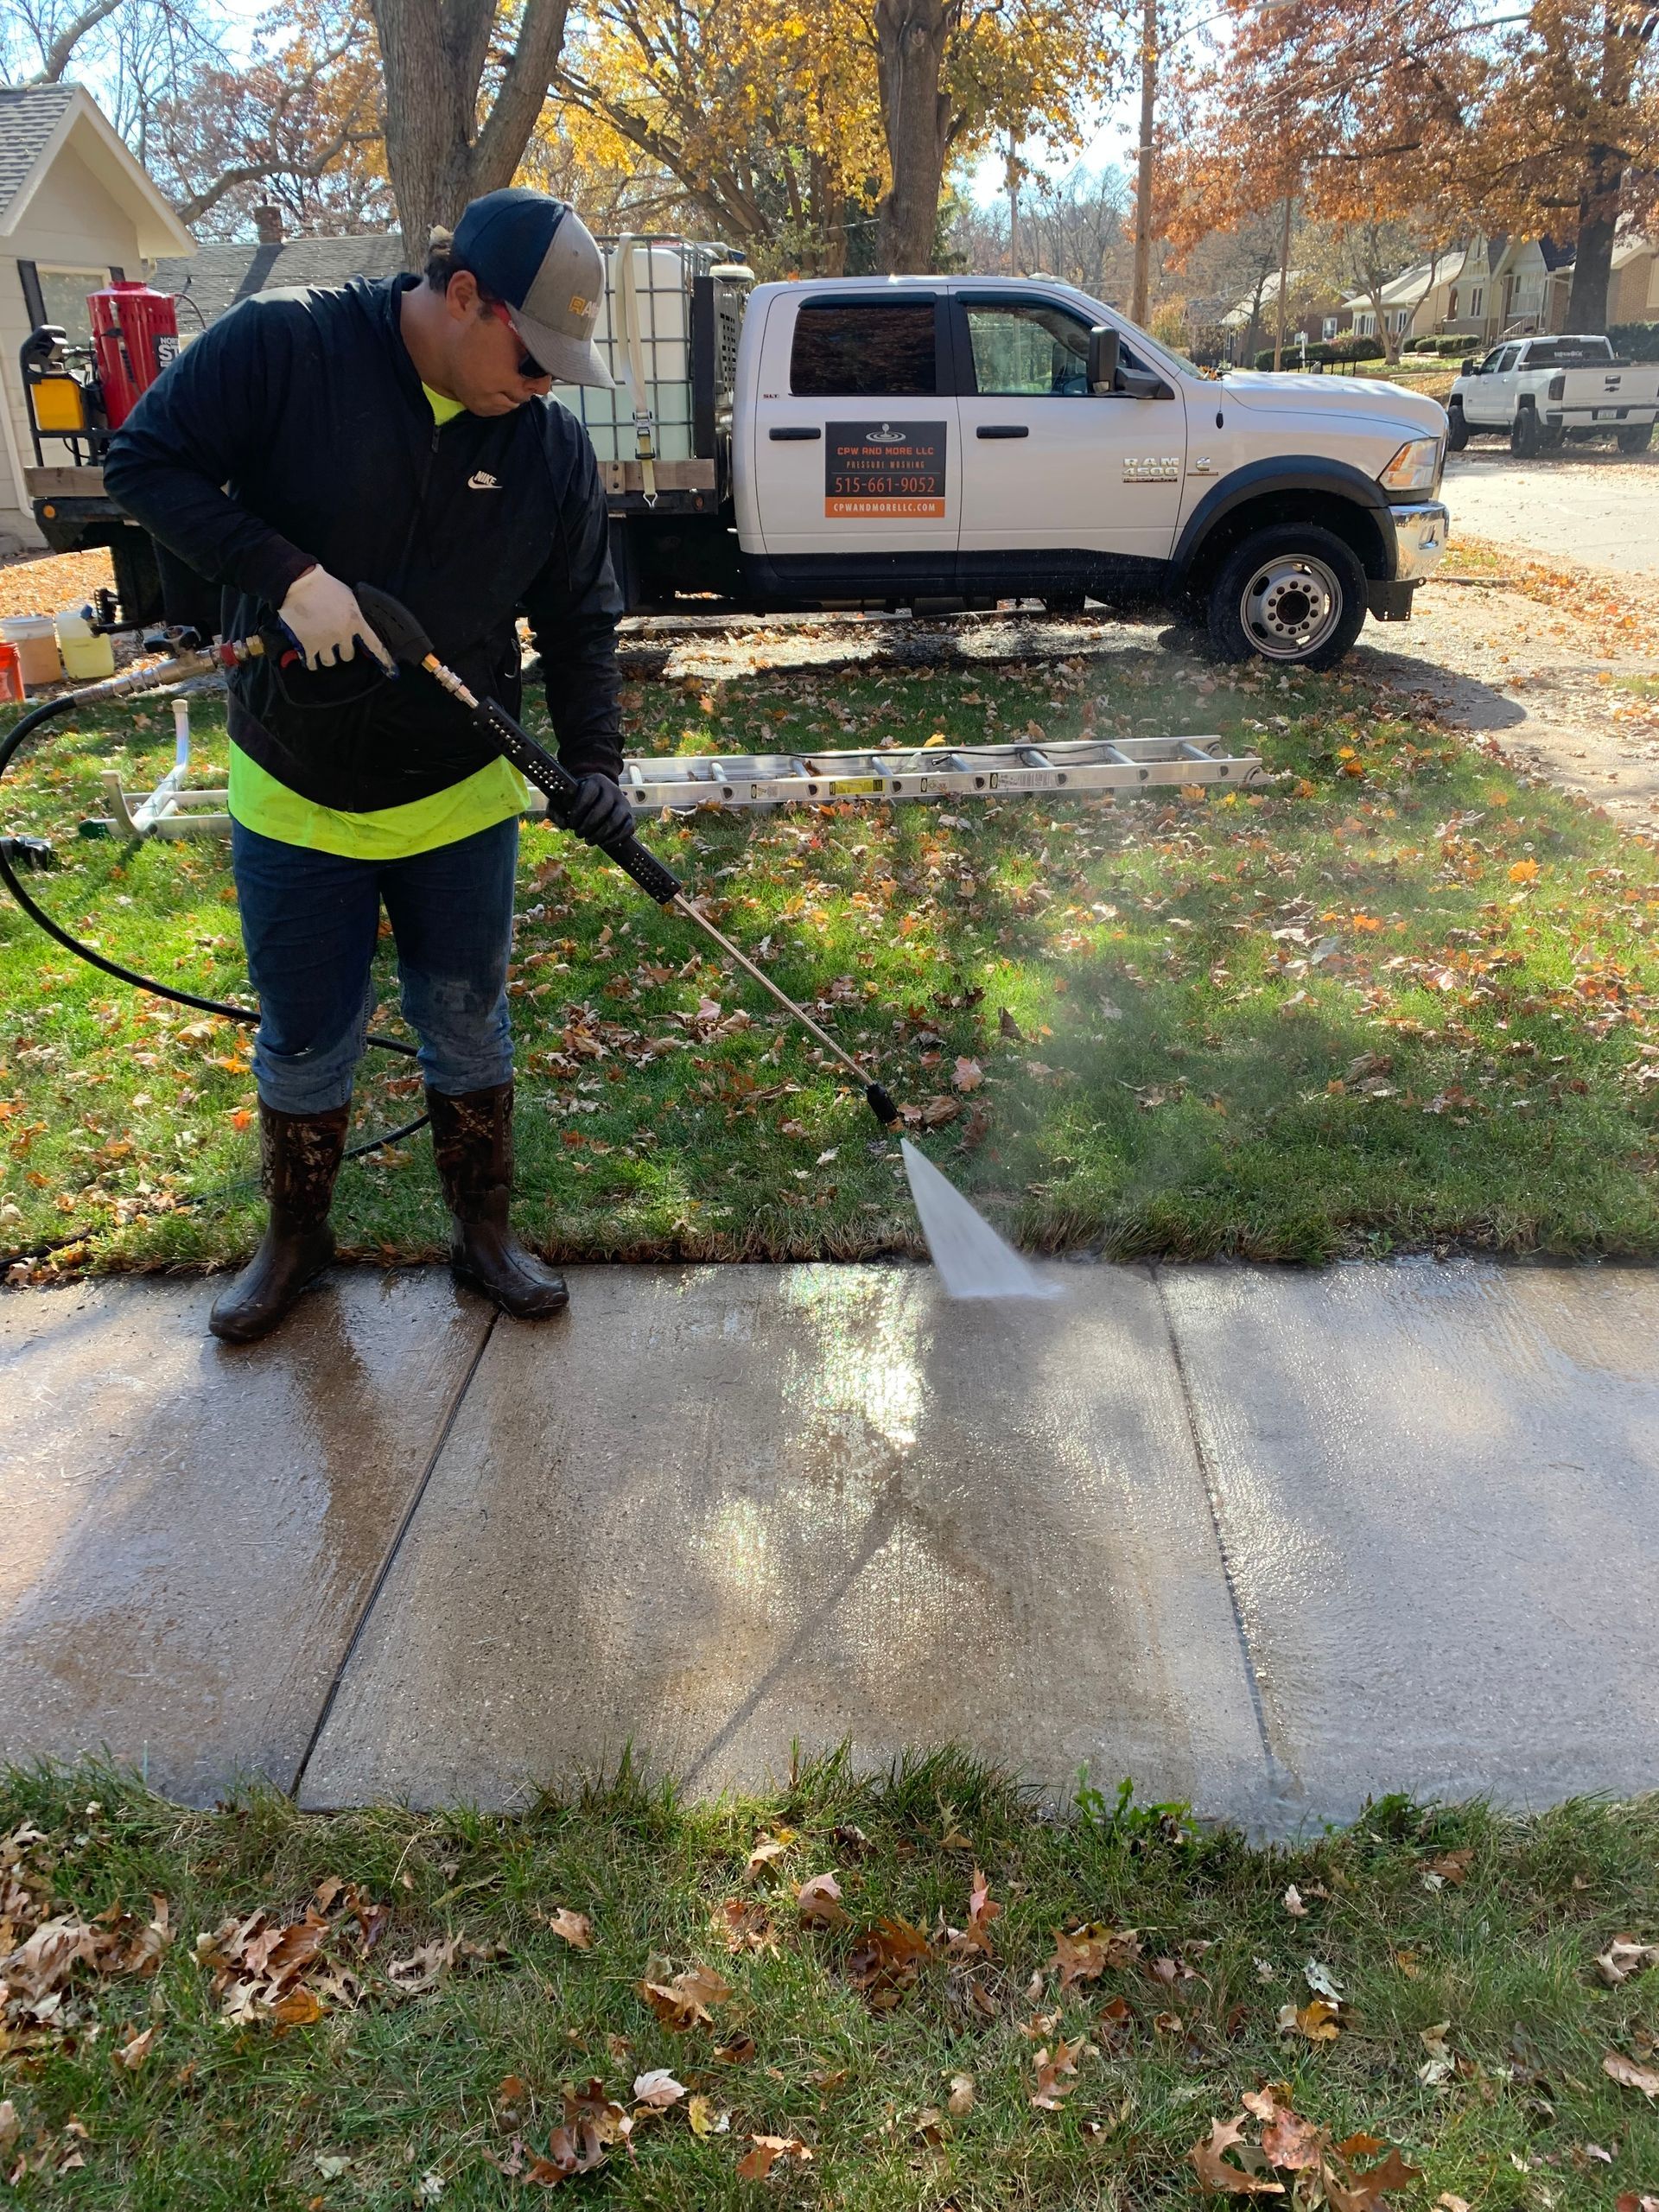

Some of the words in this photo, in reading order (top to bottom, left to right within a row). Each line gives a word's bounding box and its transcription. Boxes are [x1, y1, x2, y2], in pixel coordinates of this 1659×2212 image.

[837, 447, 859, 455] CPW
[862, 447, 882, 455] AND
[885, 447, 913, 455] MORE
[916, 447, 934, 455] LLC
[890, 461, 925, 469] WASHING
[1124, 458, 1179, 467] RAM
[1123, 467, 1179, 476] 4500
[474, 471, 497, 484] NIKE
[835, 477, 935, 493] 515-661-9052
[834, 503, 936, 512] CPWANDMORELLC.COM
